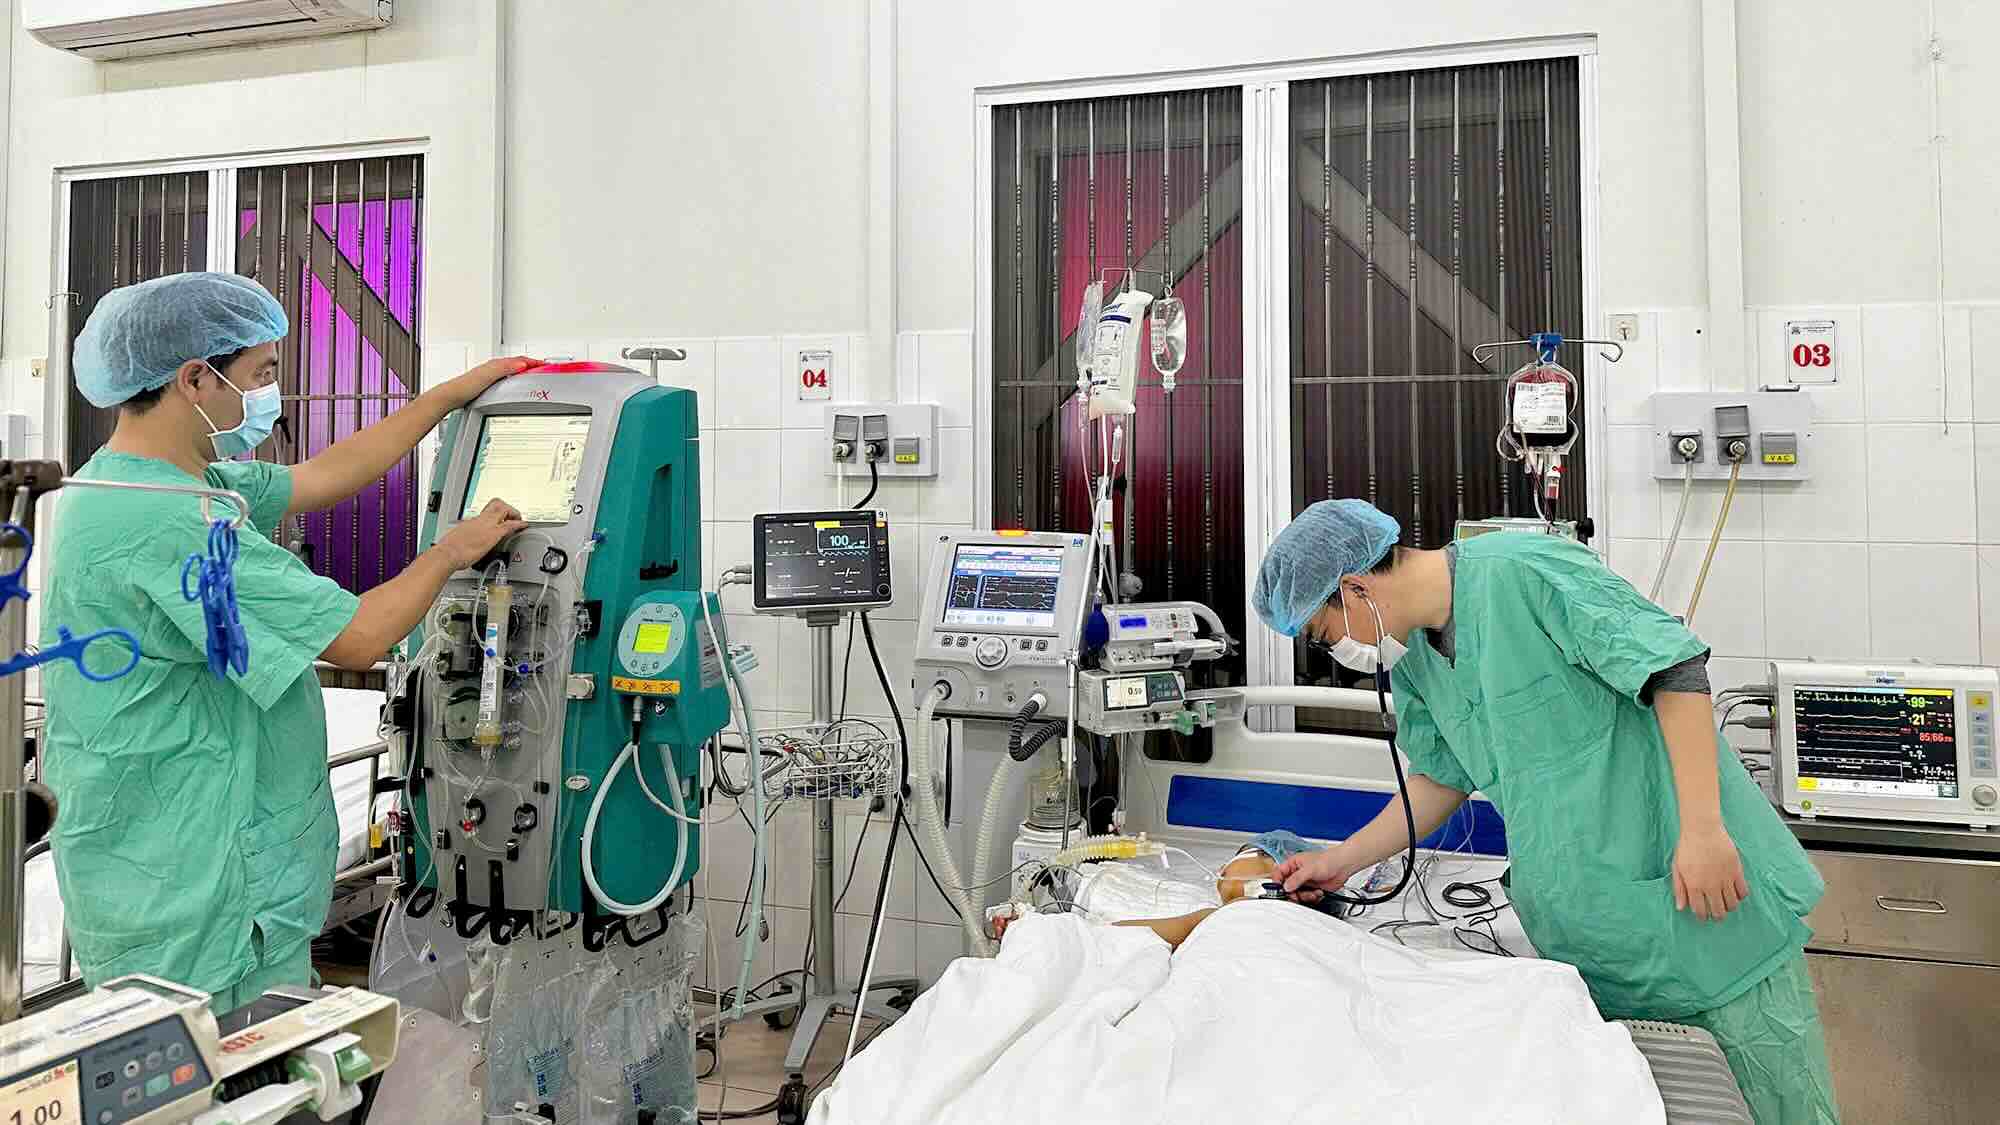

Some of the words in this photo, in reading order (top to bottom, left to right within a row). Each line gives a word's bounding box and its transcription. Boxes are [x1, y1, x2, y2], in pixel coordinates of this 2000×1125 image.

[1793, 344, 1831, 367] 03
[802, 369, 827, 388] 04
[830, 535, 849, 547] 100
[1911, 696, 1925, 708] 99
[1912, 714, 1925, 725] 21
[9, 1099, 62, 1125] 100
